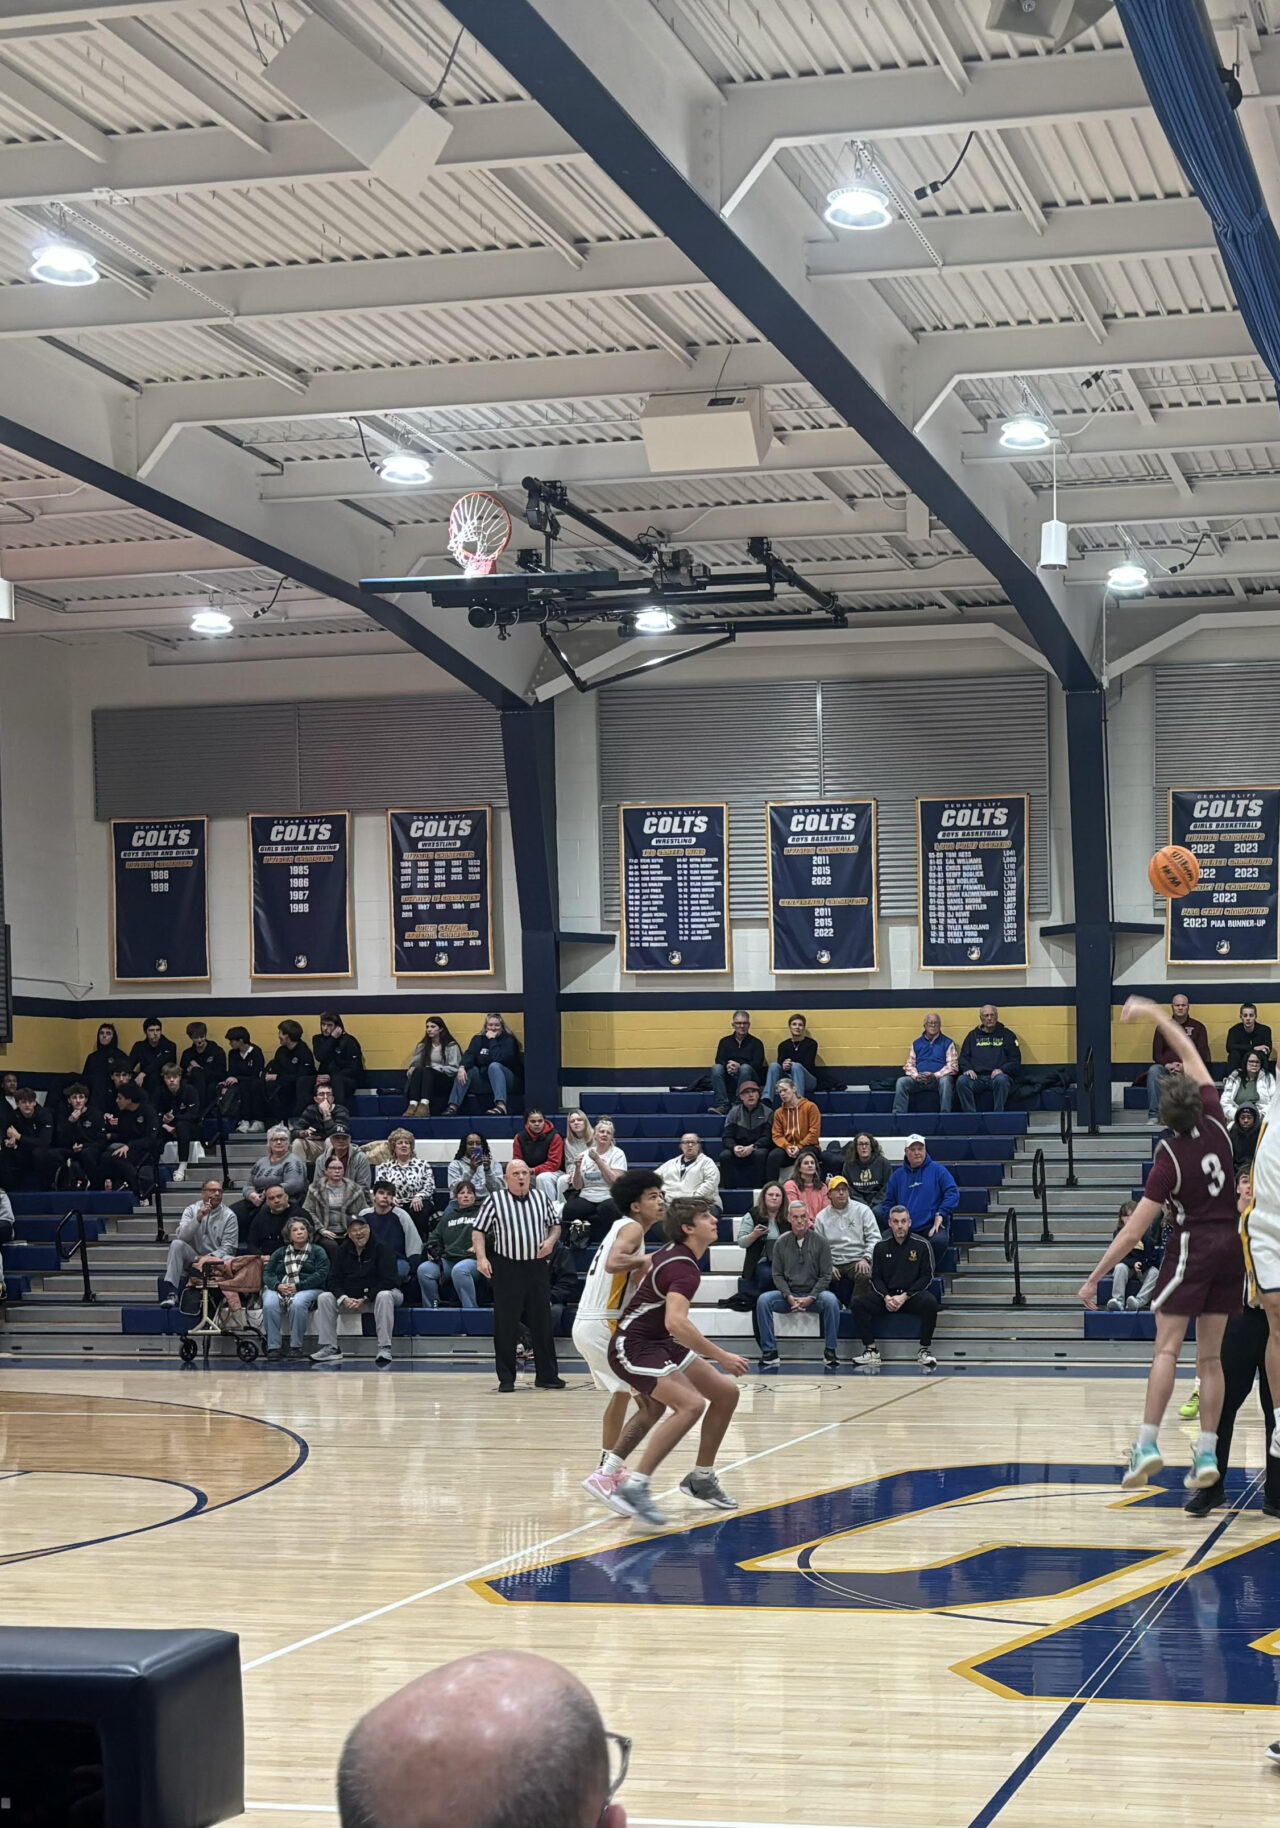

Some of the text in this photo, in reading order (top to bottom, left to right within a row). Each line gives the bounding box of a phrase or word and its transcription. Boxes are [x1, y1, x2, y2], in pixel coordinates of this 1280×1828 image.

[1193, 799, 1263, 818] COLTS
[790, 813, 856, 832] COLTS
[941, 808, 1008, 827] COLTS
[410, 820, 472, 837] COLTS
[643, 816, 708, 834] COLTS
[270, 824, 332, 841] COLTS
[132, 829, 191, 847] COLTS
[1192, 843, 1258, 853] 2022 2023
[813, 856, 829, 864] 2011
[813, 866, 830, 874] 2015
[1199, 868, 1258, 878] 022 2023
[812, 877, 831, 885] 2022
[1213, 893, 1236, 903] 2023
[815, 908, 831, 916] 2011
[815, 918, 832, 926] 2015
[1184, 918, 1207, 927] 2023
[814, 929, 833, 937] 2022
[1201, 1153, 1225, 1197] 3
